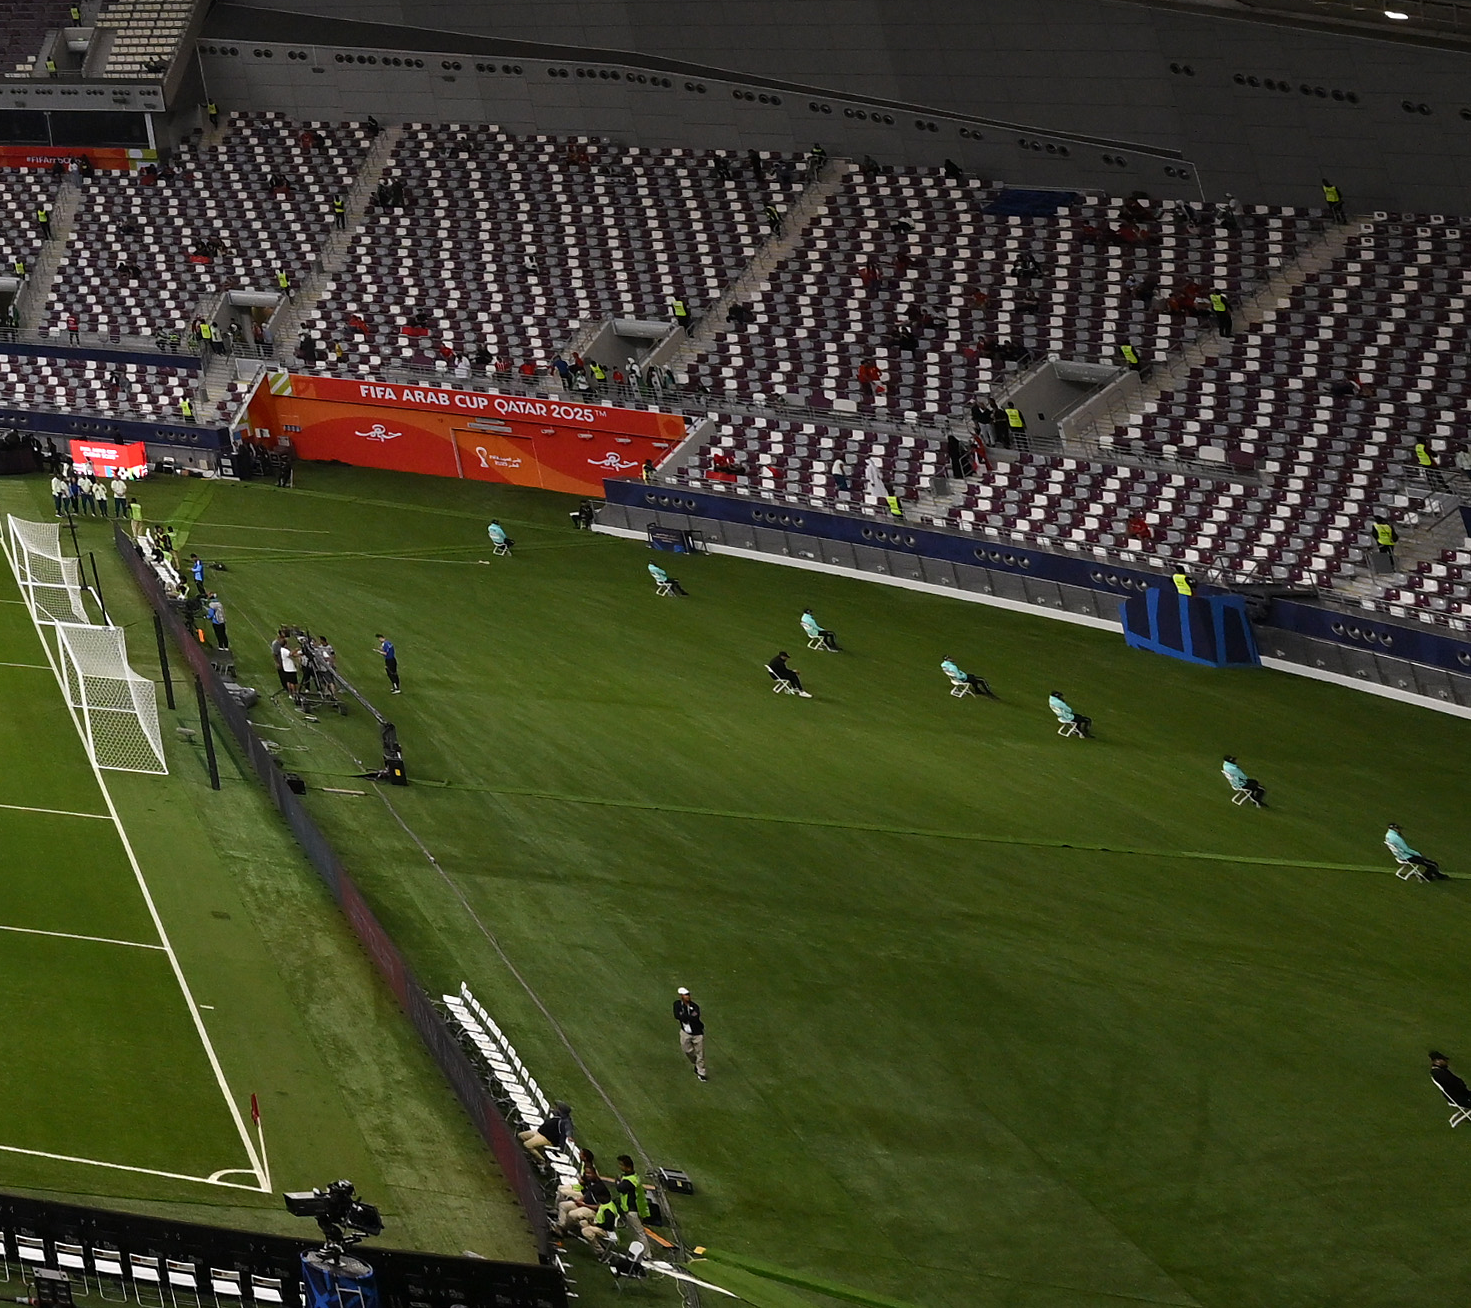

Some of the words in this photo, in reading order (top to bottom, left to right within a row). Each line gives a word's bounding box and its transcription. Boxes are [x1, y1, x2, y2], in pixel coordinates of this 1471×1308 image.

[360, 385, 397, 400] FIFA
[402, 389, 451, 406] ARAB
[454, 394, 489, 410] CUP
[494, 398, 548, 417] QATAR
